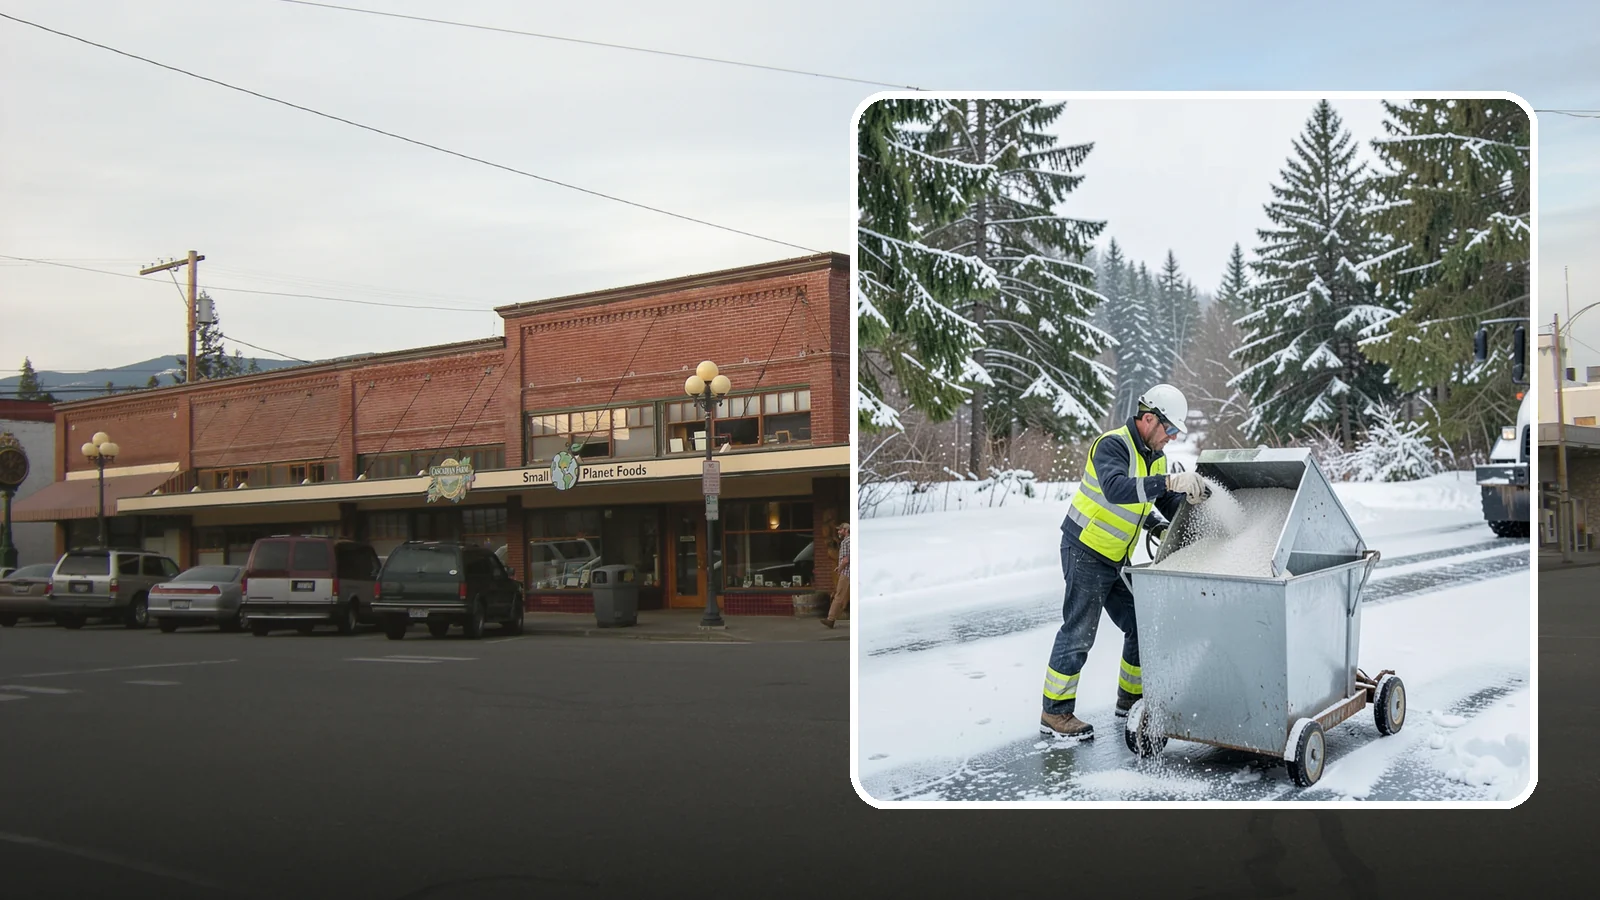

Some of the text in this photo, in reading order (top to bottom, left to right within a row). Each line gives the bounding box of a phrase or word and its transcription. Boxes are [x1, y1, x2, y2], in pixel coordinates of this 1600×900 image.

[431, 466, 469, 476] CASCADIAN FARM
[523, 464, 647, 483] Small Planet Foods
